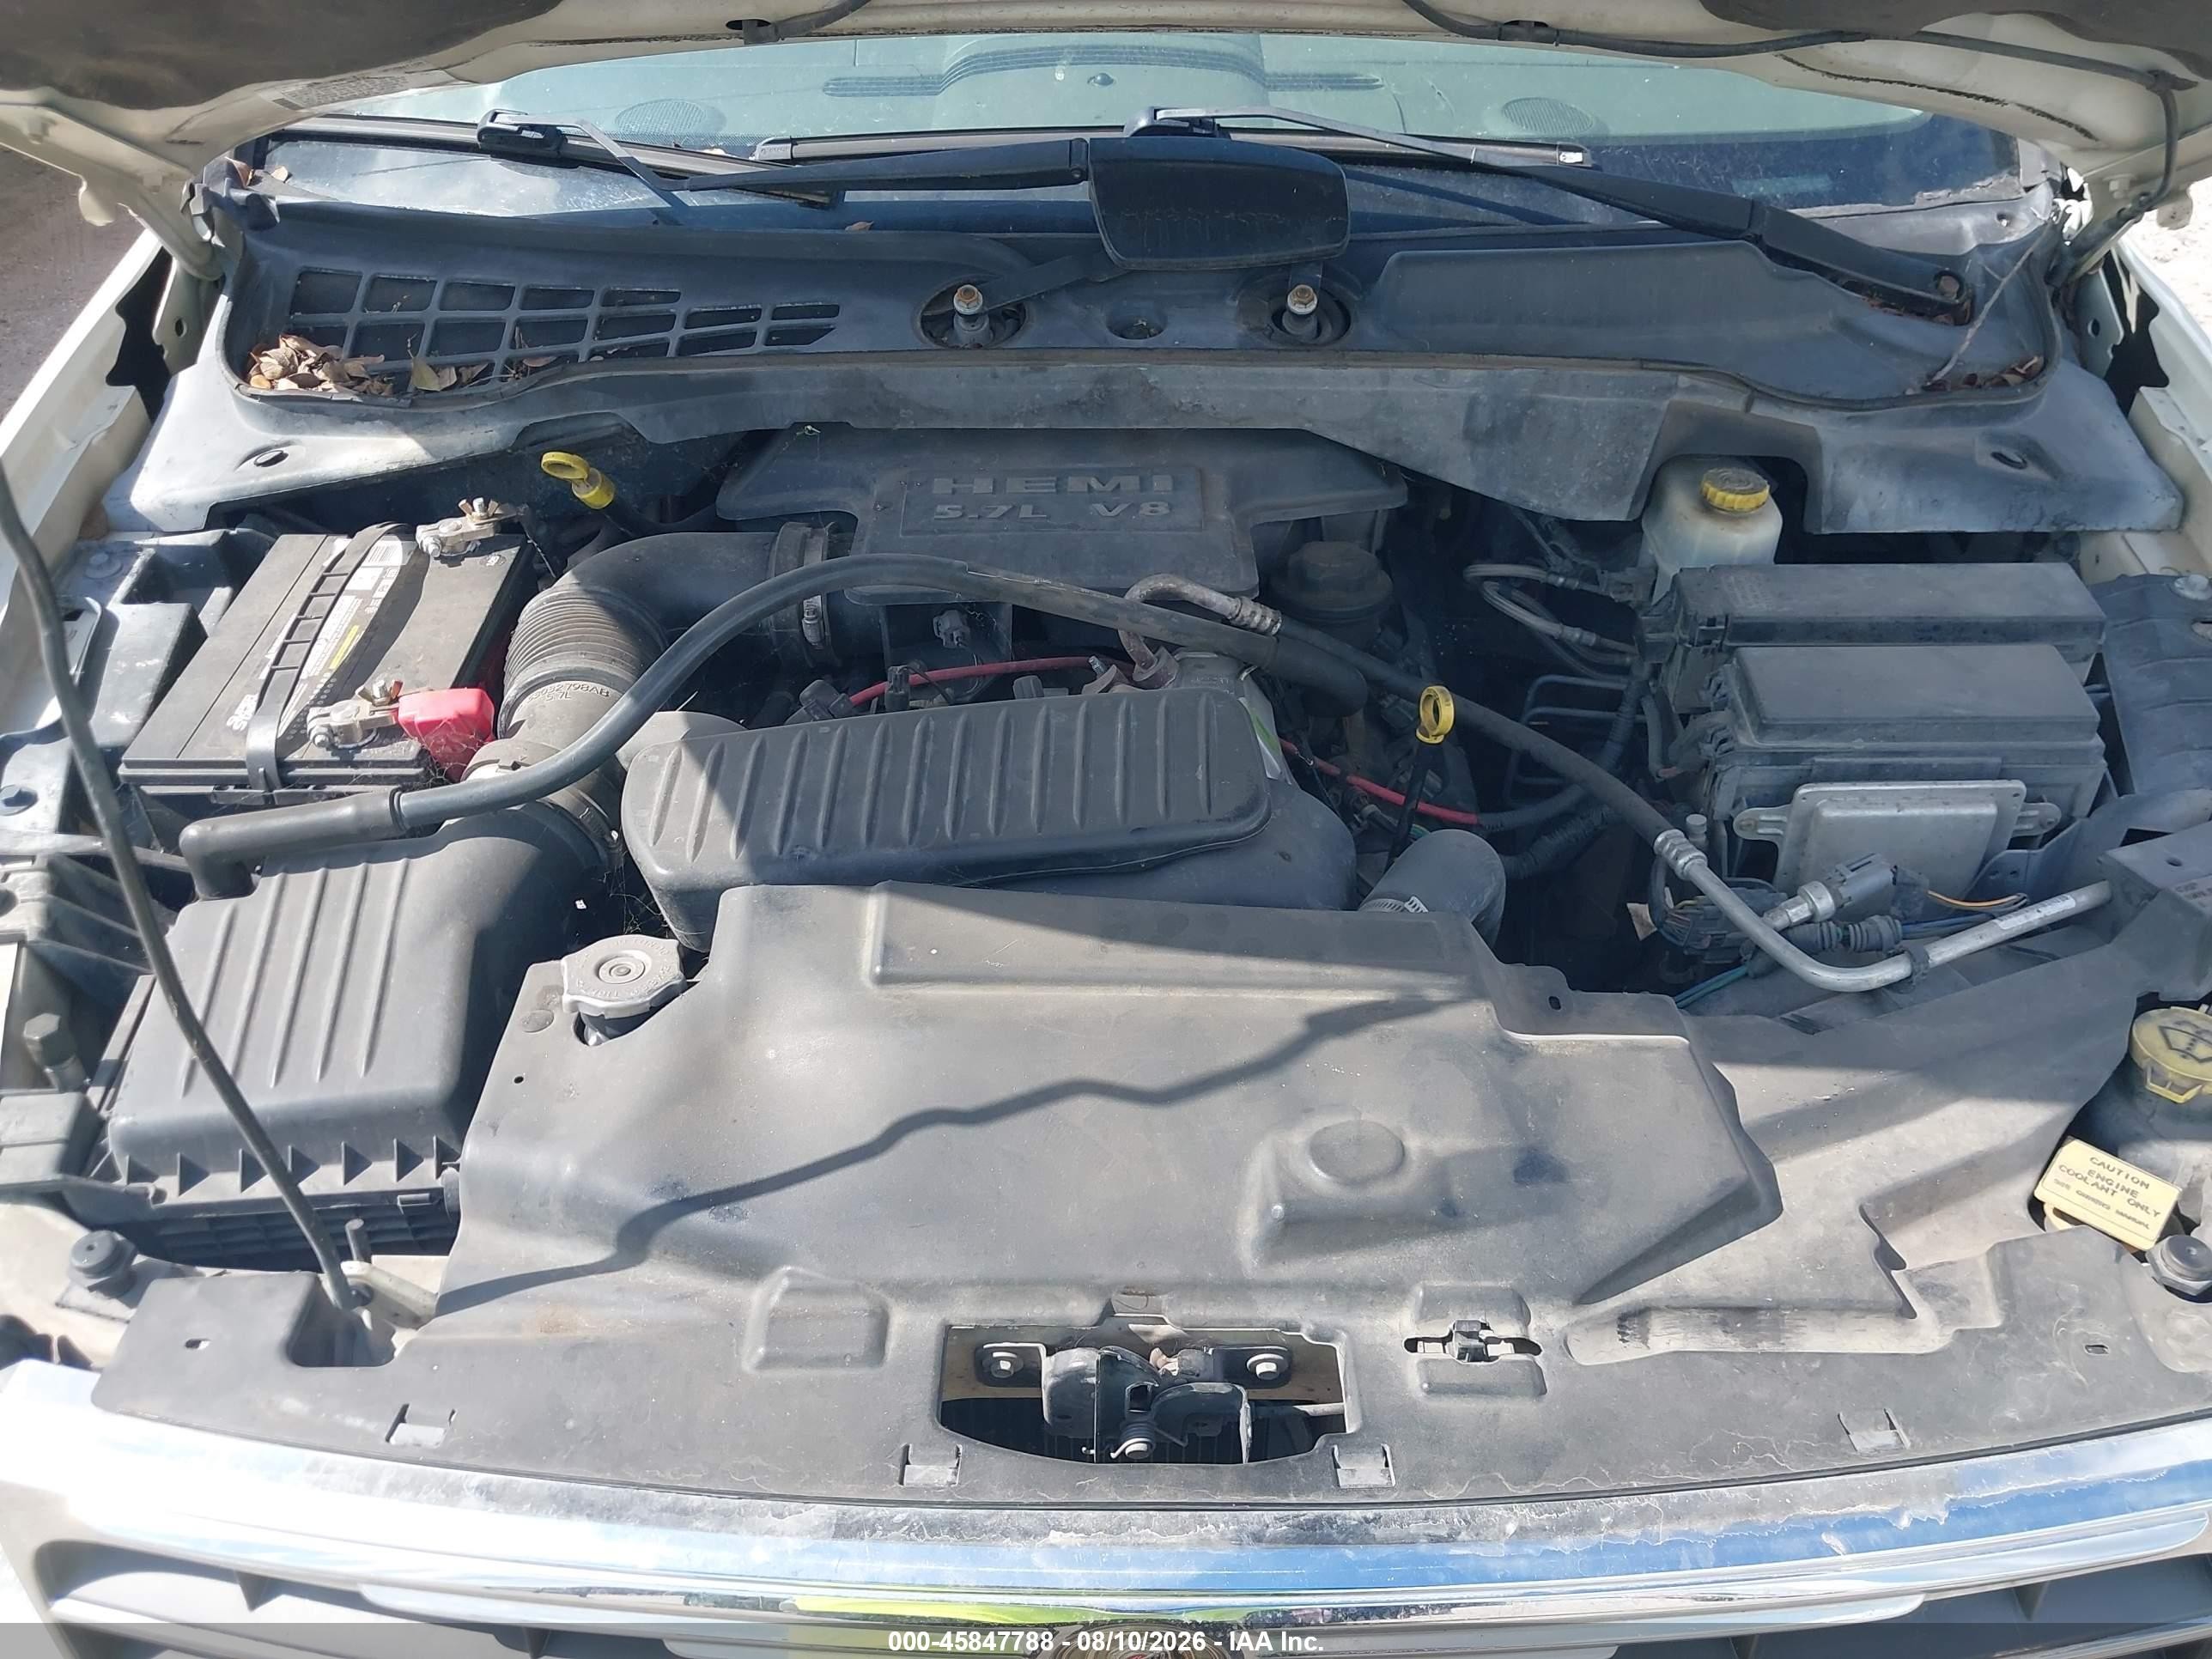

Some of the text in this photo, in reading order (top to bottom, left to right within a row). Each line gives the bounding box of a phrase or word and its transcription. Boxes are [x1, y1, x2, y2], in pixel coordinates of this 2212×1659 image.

[933, 476, 1174, 494] HEMI
[934, 501, 1170, 520] 5.7L V8
[2087, 1169, 2140, 1199] ENGINE
[2089, 1156, 2150, 1190] CAUTION
[2058, 1164, 2118, 1197] COOLANT
[2127, 1198, 2161, 1218] ONLY
